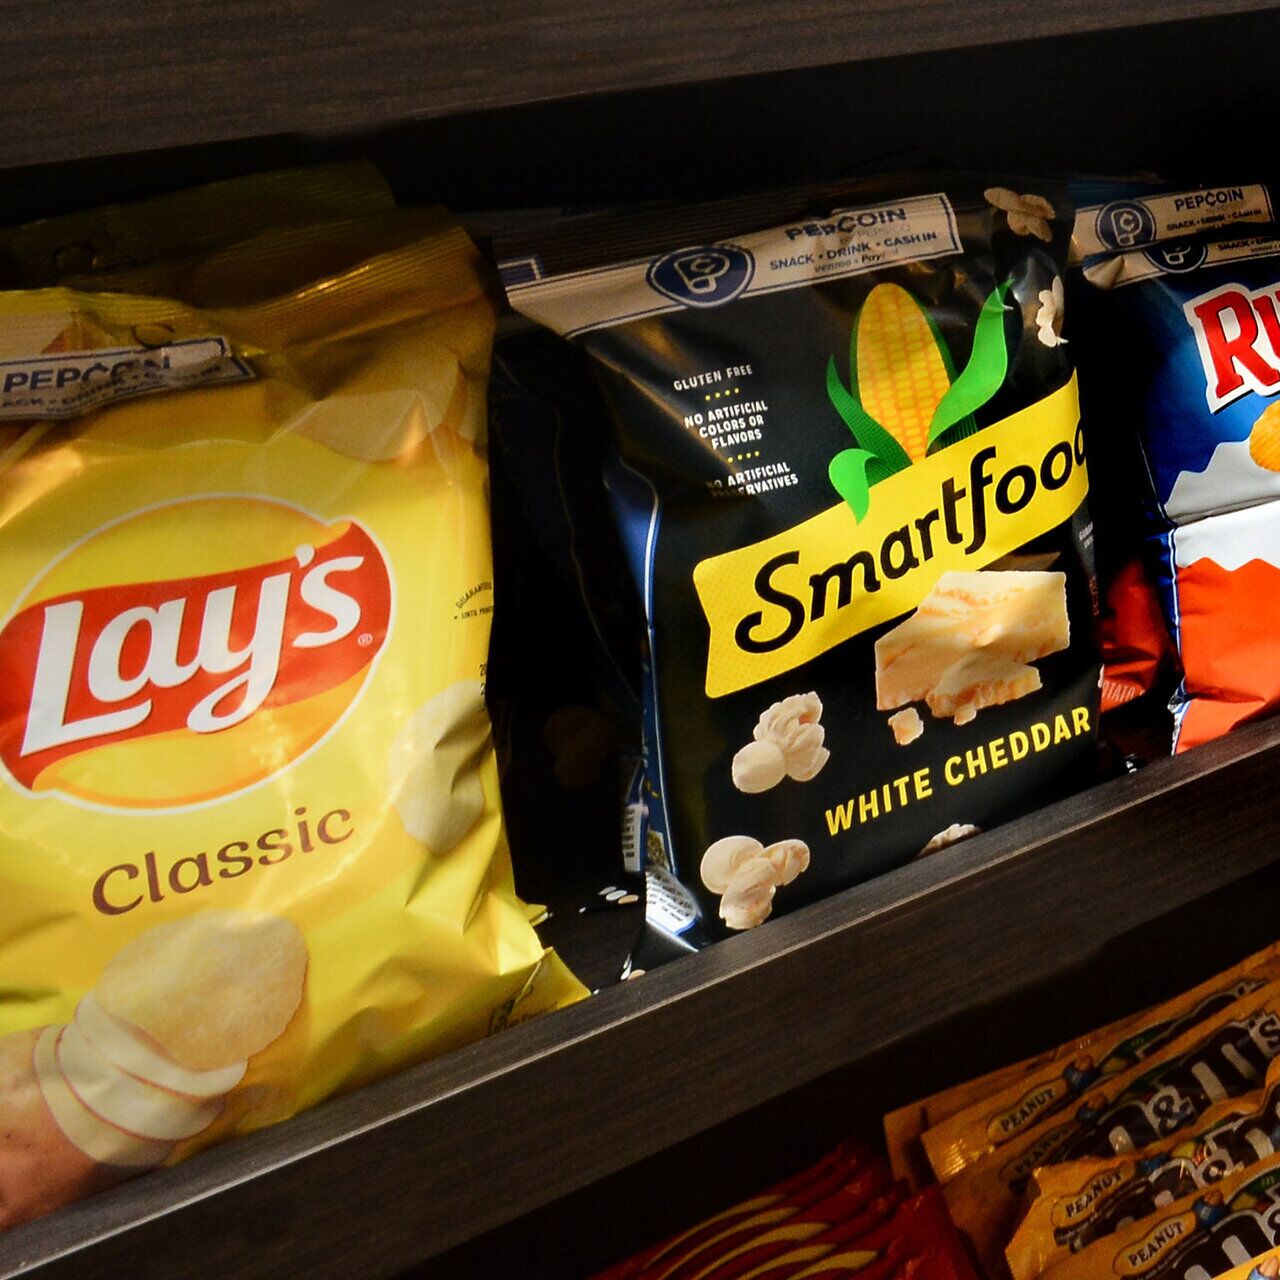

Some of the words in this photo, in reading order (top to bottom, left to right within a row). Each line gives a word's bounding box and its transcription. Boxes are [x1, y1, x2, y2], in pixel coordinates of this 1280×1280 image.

[1174, 188, 1244, 212] PEPCOIN
[769, 253, 813, 271] SNACK
[826, 241, 871, 261] DRINK
[883, 233, 919, 248] CASH
[673, 370, 722, 391] GLUTEN
[726, 364, 753, 381] FREE
[684, 412, 704, 429] NO
[707, 400, 769, 423] ARTIFICIAL
[699, 419, 745, 439] COLORS
[749, 414, 765, 428] OR
[711, 428, 763, 450] FLAVORS
[727, 462, 791, 486] ARTIFICIAL
[21, 545, 364, 757] Lay's
[825, 768, 934, 835] WHITE
[944, 706, 1091, 787] CHEDDAR
[91, 806, 355, 916] Classic
[1000, 1086, 1055, 1130] PEANUT
[1064, 1166, 1124, 1218] PEANUT
[1128, 1219, 1185, 1268] PEANUT
